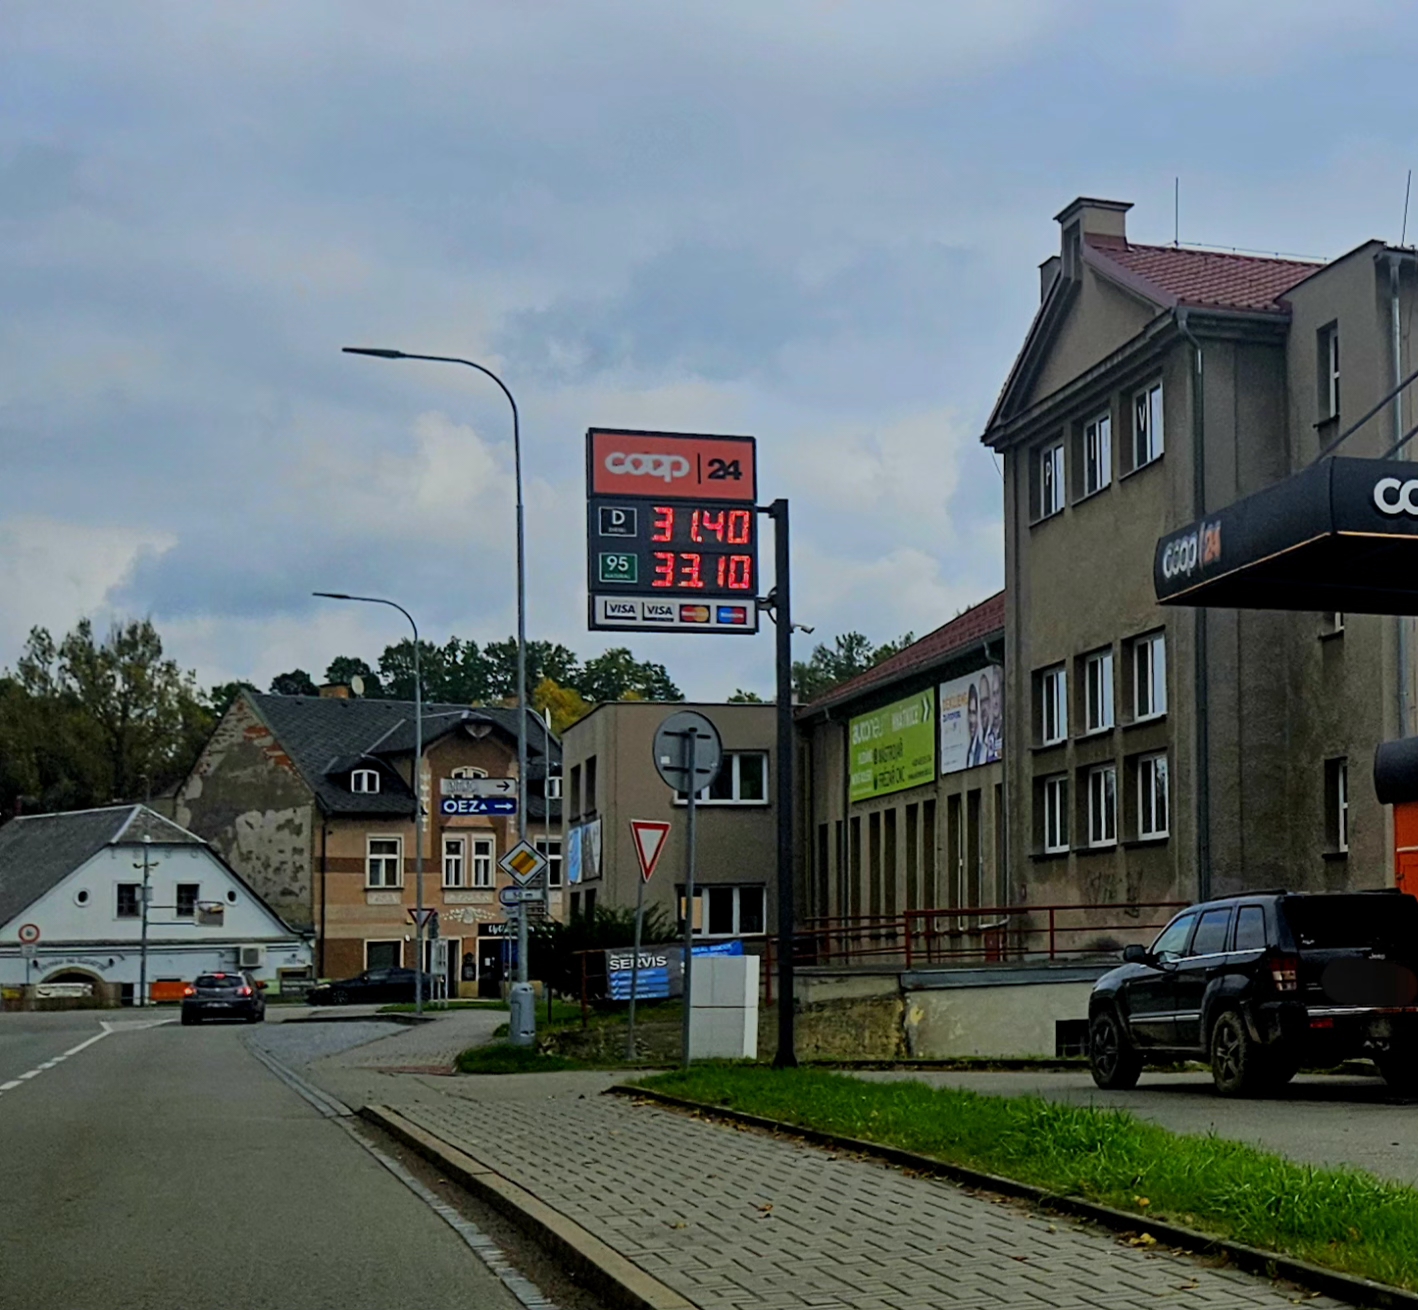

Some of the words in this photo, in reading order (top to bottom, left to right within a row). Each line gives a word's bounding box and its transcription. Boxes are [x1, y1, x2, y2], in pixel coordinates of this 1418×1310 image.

[1045, 460, 1052, 487] P
[1138, 403, 1146, 432] V
[605, 452, 690, 483] coop
[707, 458, 743, 481] 24
[612, 509, 626, 525] D
[651, 506, 751, 545] 31.40
[1162, 535, 1197, 580] coop
[1204, 519, 1221, 562] 24
[606, 555, 629, 572] 95
[609, 603, 636, 614] VISA
[646, 605, 673, 616] VISA
[443, 799, 480, 813] OEZ
[609, 955, 668, 971] SERVIS
